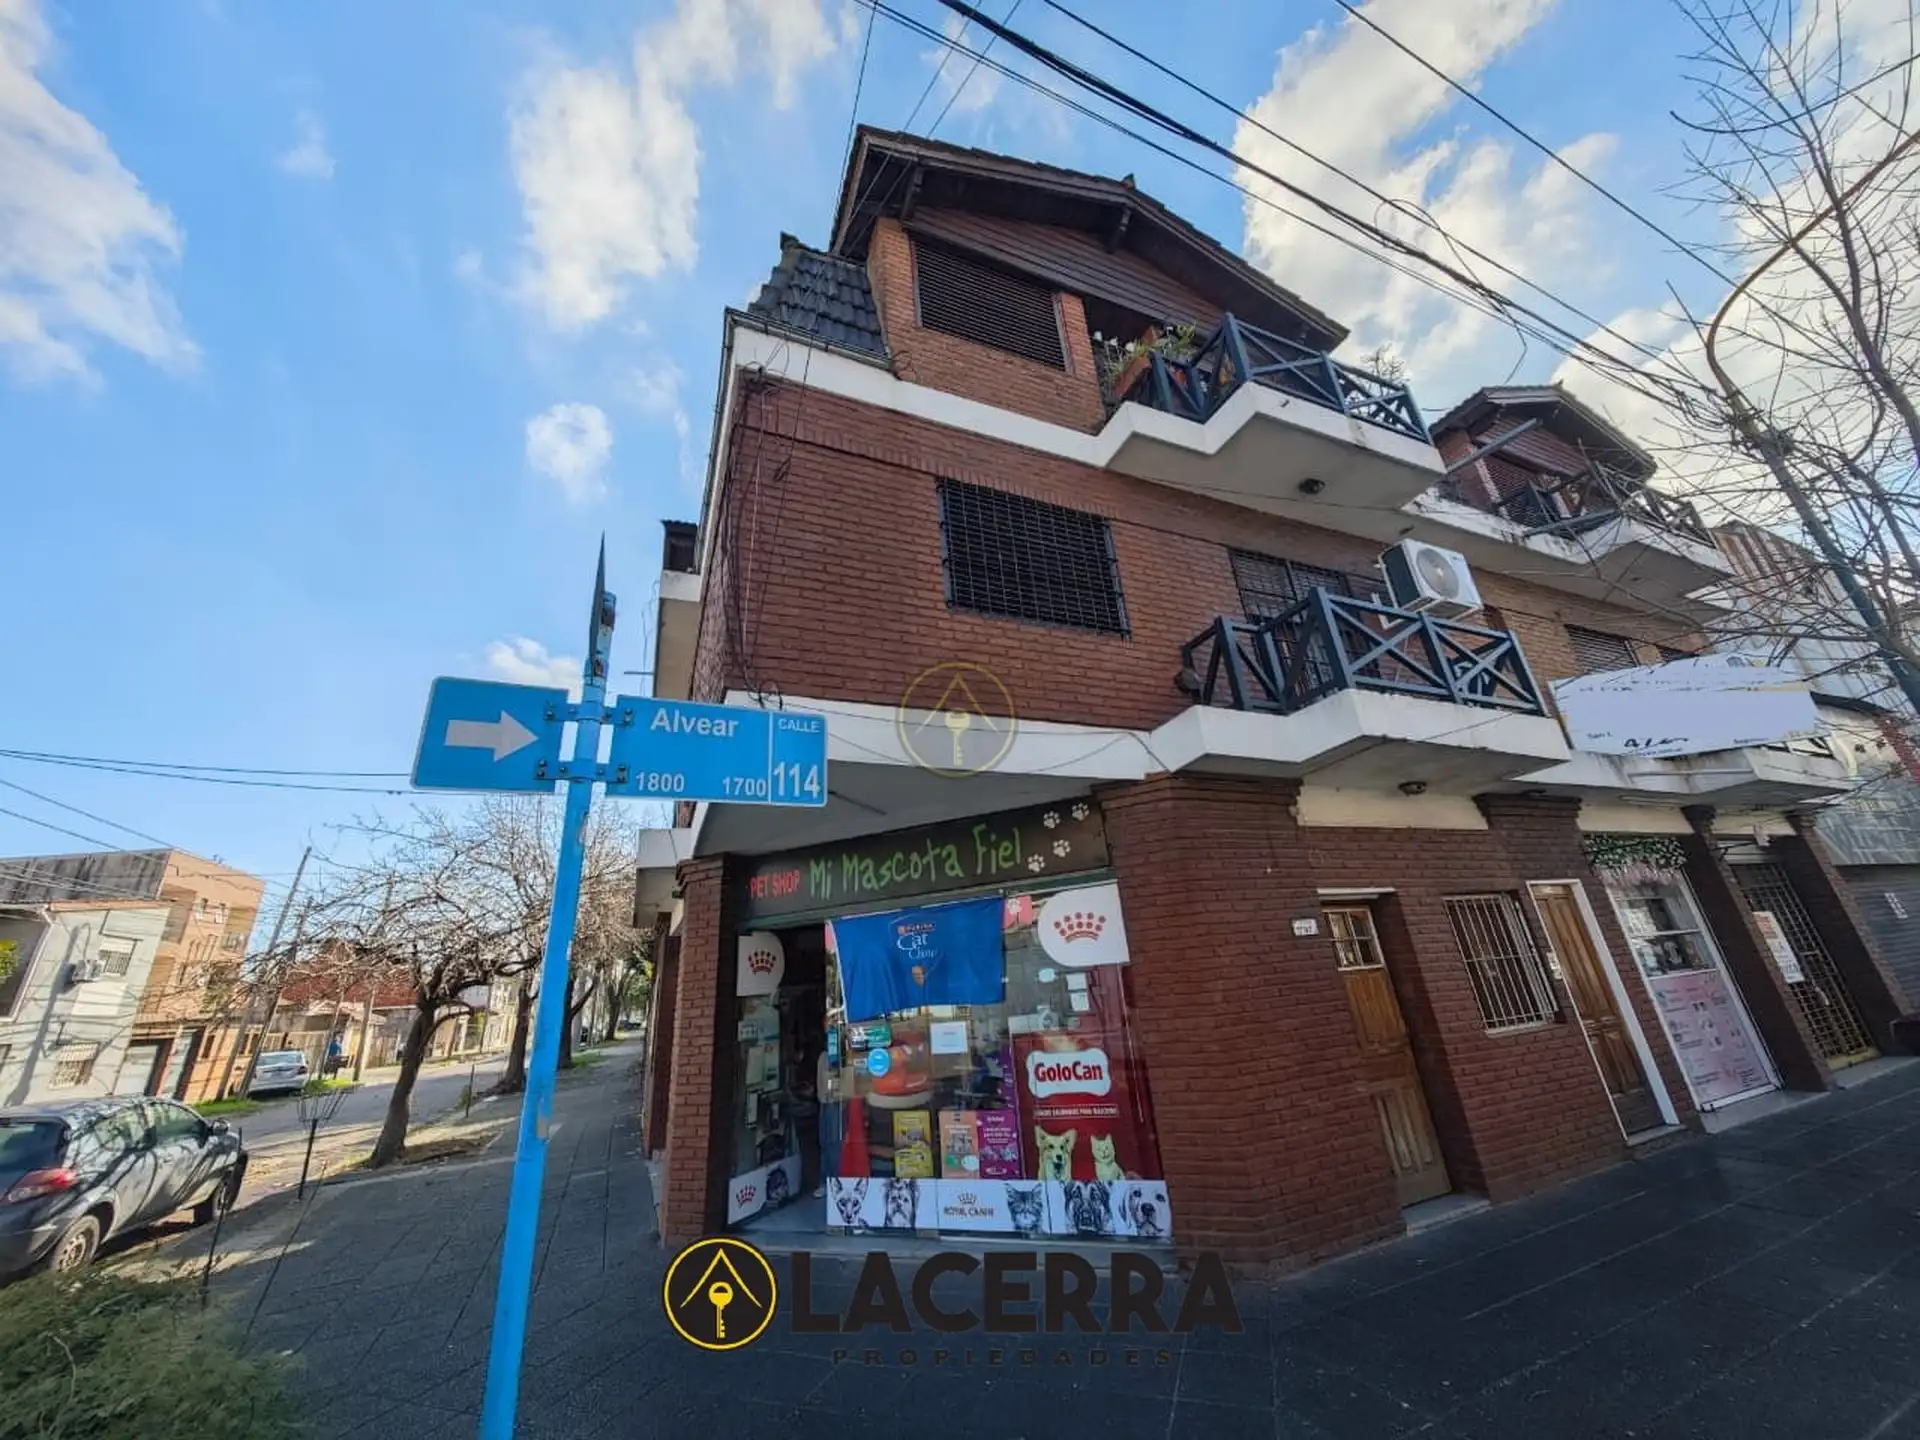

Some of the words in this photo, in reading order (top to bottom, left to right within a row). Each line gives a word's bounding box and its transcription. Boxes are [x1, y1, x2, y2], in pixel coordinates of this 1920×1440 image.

[650, 708, 739, 738] Alvear
[778, 717, 821, 734] CALLE
[635, 770, 685, 793] 1800
[721, 776, 766, 799] 1700
[772, 761, 821, 799] 114
[749, 874, 769, 900] PET
[771, 869, 801, 898] SHOP
[809, 858, 833, 901] Mi
[841, 837, 965, 895] Mascota
[972, 823, 1022, 876] Fiel
[896, 932, 929, 951] Cat
[1034, 1060, 1104, 1083] GoloCan
